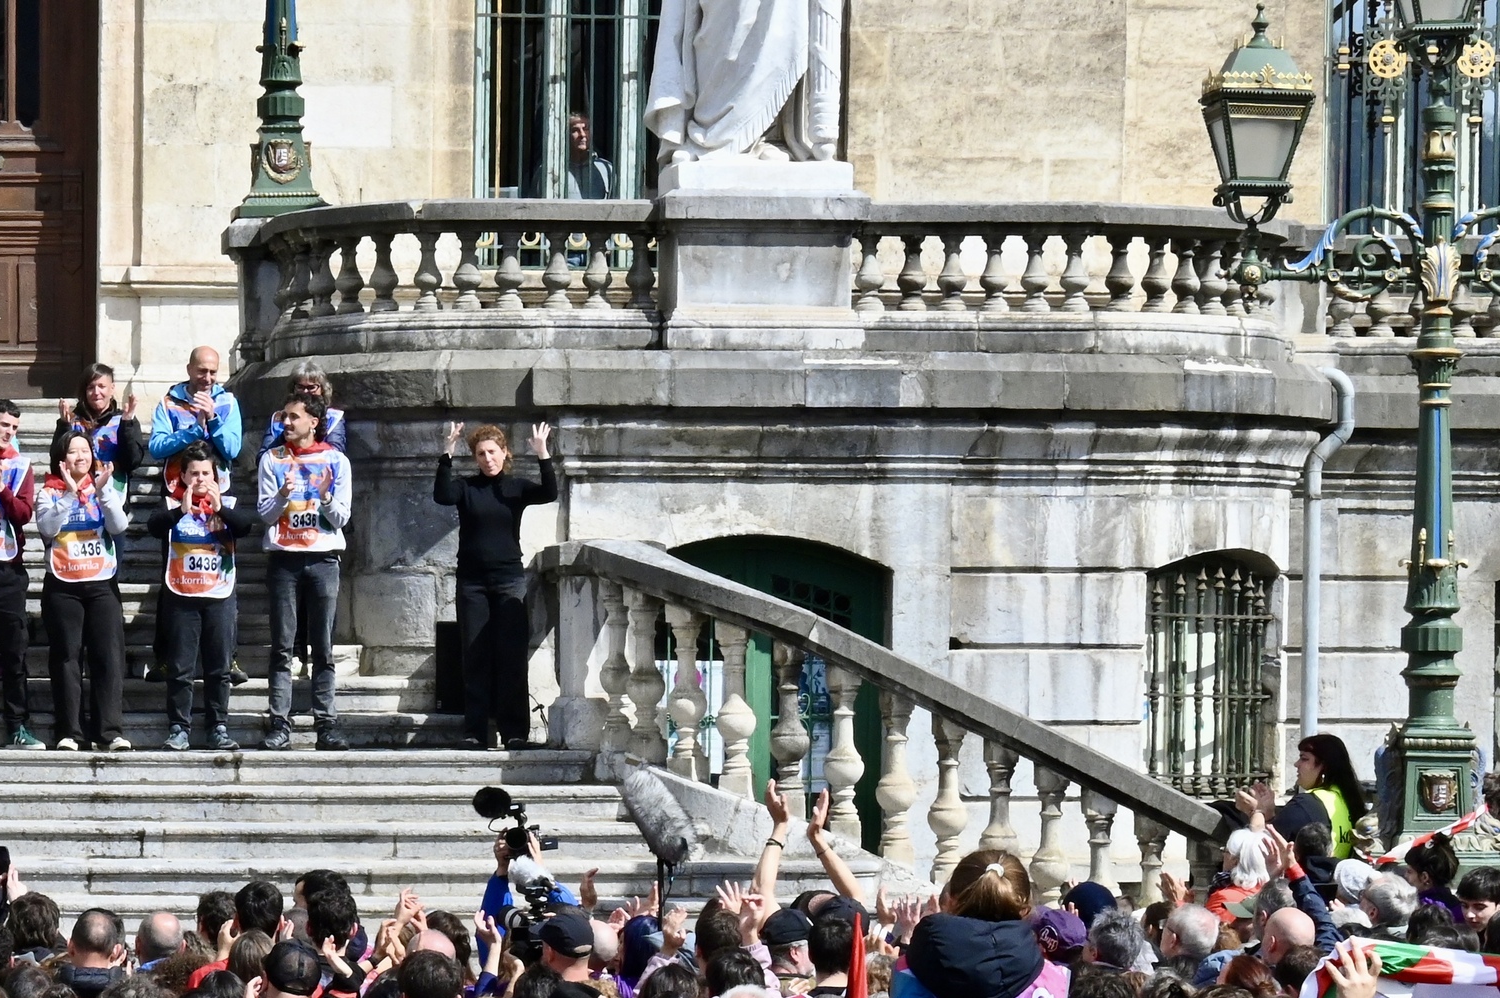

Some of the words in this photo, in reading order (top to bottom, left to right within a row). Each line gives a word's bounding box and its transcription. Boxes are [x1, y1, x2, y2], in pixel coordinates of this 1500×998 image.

[292, 513, 317, 528] 3436
[73, 542, 101, 556] 3436
[188, 556, 218, 571] 3436
